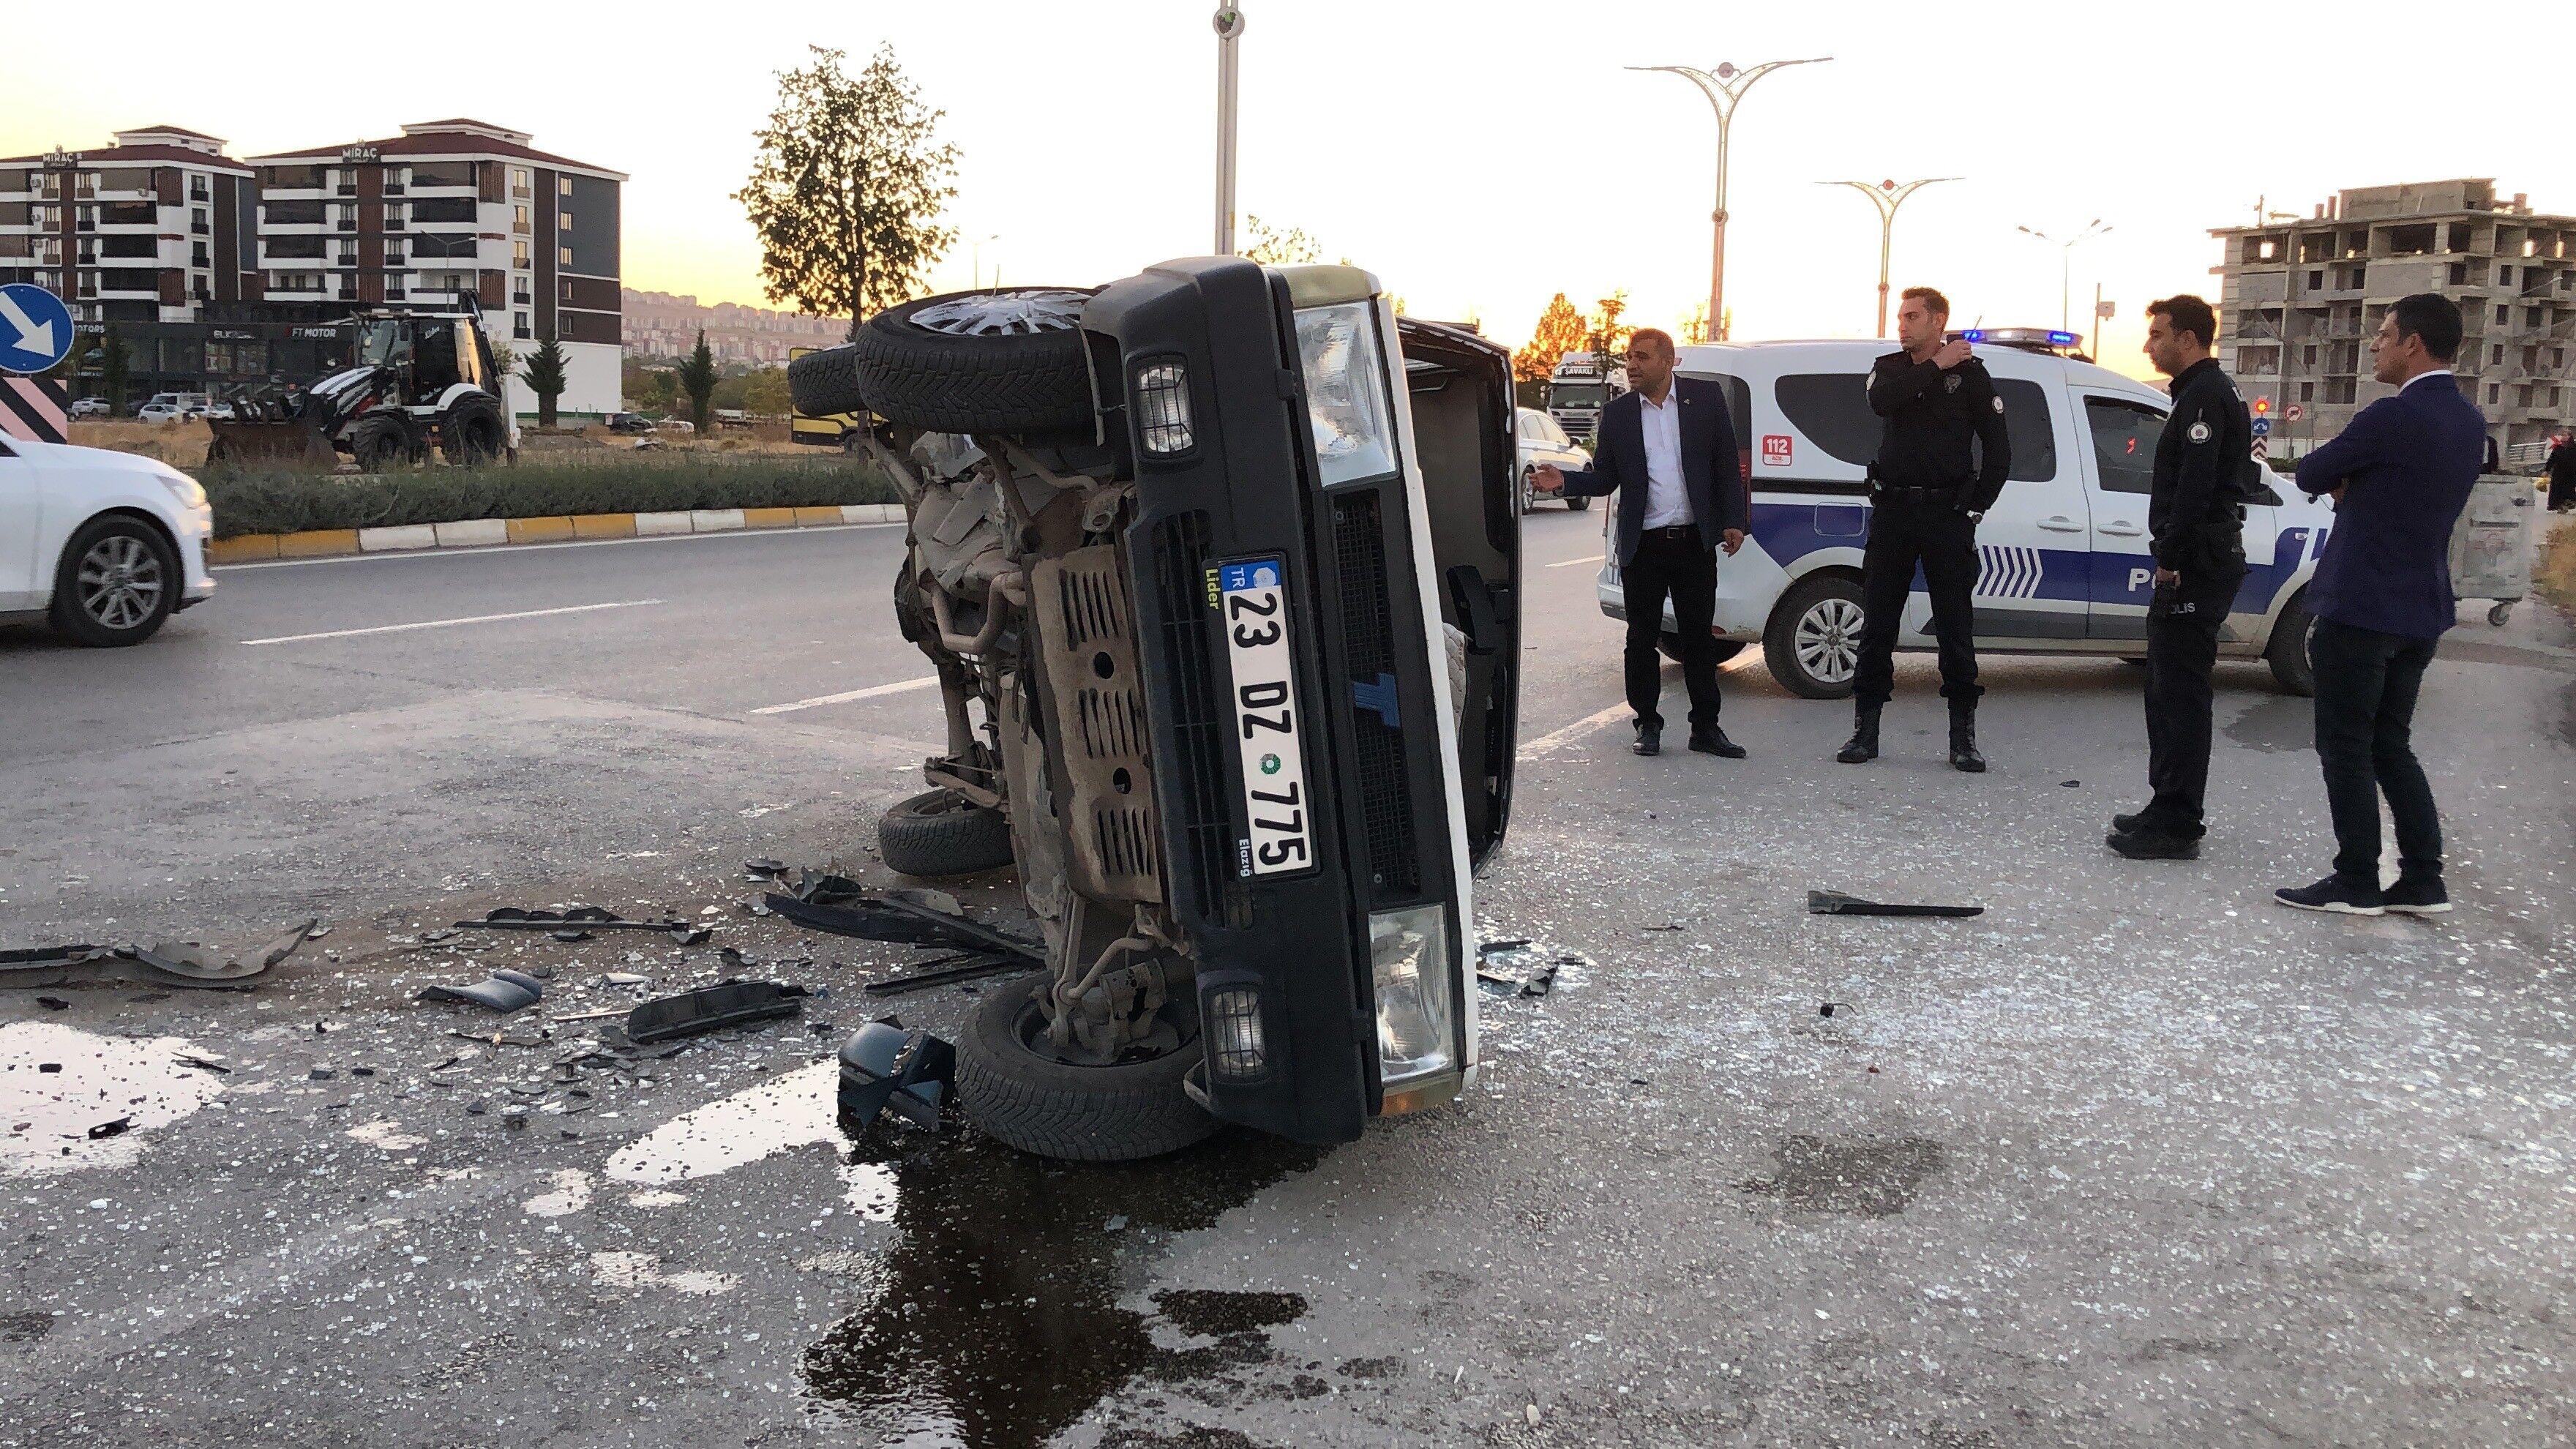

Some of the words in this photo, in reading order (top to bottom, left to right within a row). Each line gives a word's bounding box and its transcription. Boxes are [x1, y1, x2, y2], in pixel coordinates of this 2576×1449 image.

[304, 328, 337, 338] MOTOR
[1767, 438, 1788, 454] 112
[1205, 569, 1221, 610] Lider
[1231, 567, 1246, 588] TR
[1229, 592, 1281, 648] 23
[1240, 681, 1292, 740] DZ
[1251, 781, 1306, 866] 775
